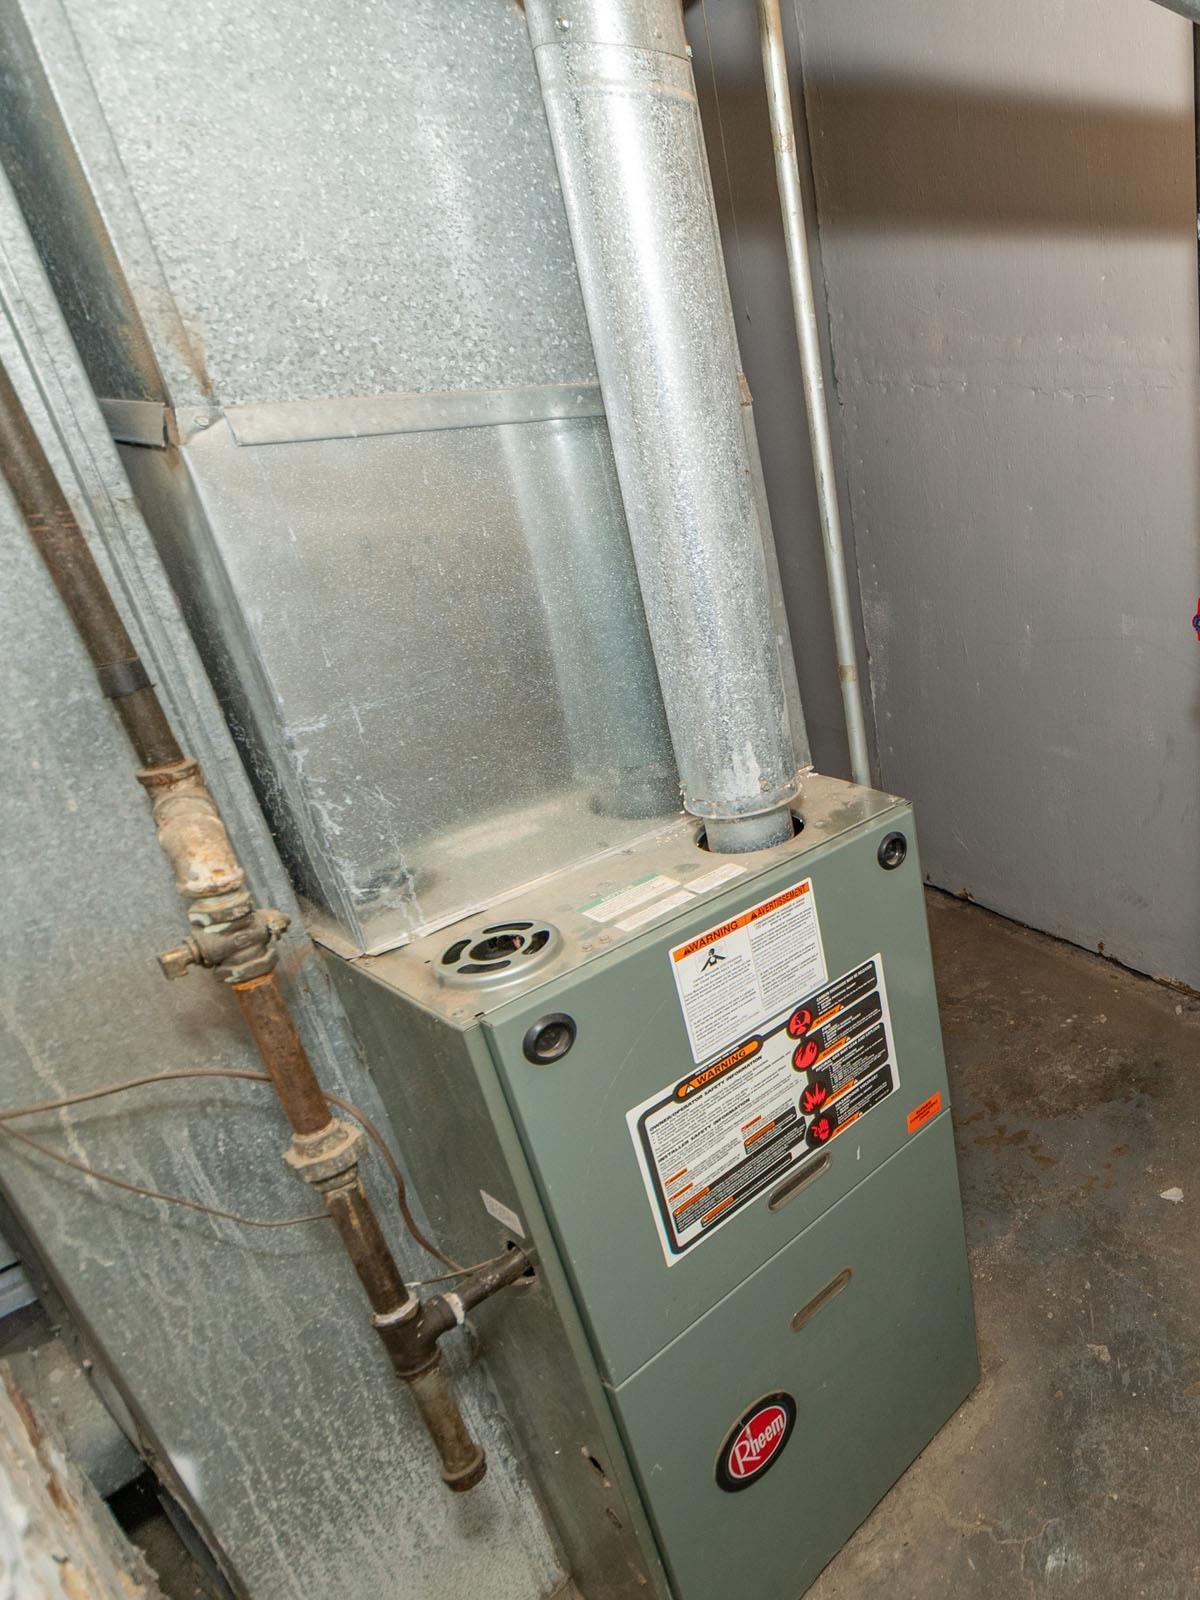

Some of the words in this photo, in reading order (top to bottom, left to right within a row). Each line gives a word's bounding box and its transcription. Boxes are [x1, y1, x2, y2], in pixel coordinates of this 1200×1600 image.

[689, 921, 738, 953] WARNING
[757, 883, 806, 917] AVERTISSEMENT
[696, 1049, 746, 1086] WARNING
[704, 1078, 725, 1096] SAFETY
[725, 1055, 763, 1082] INFORMATION
[658, 1139, 690, 1164] INSTALLER
[690, 1124, 712, 1143] SAFETY
[712, 1098, 750, 1128] INFORMATION
[734, 1413, 785, 1474] Rheem
